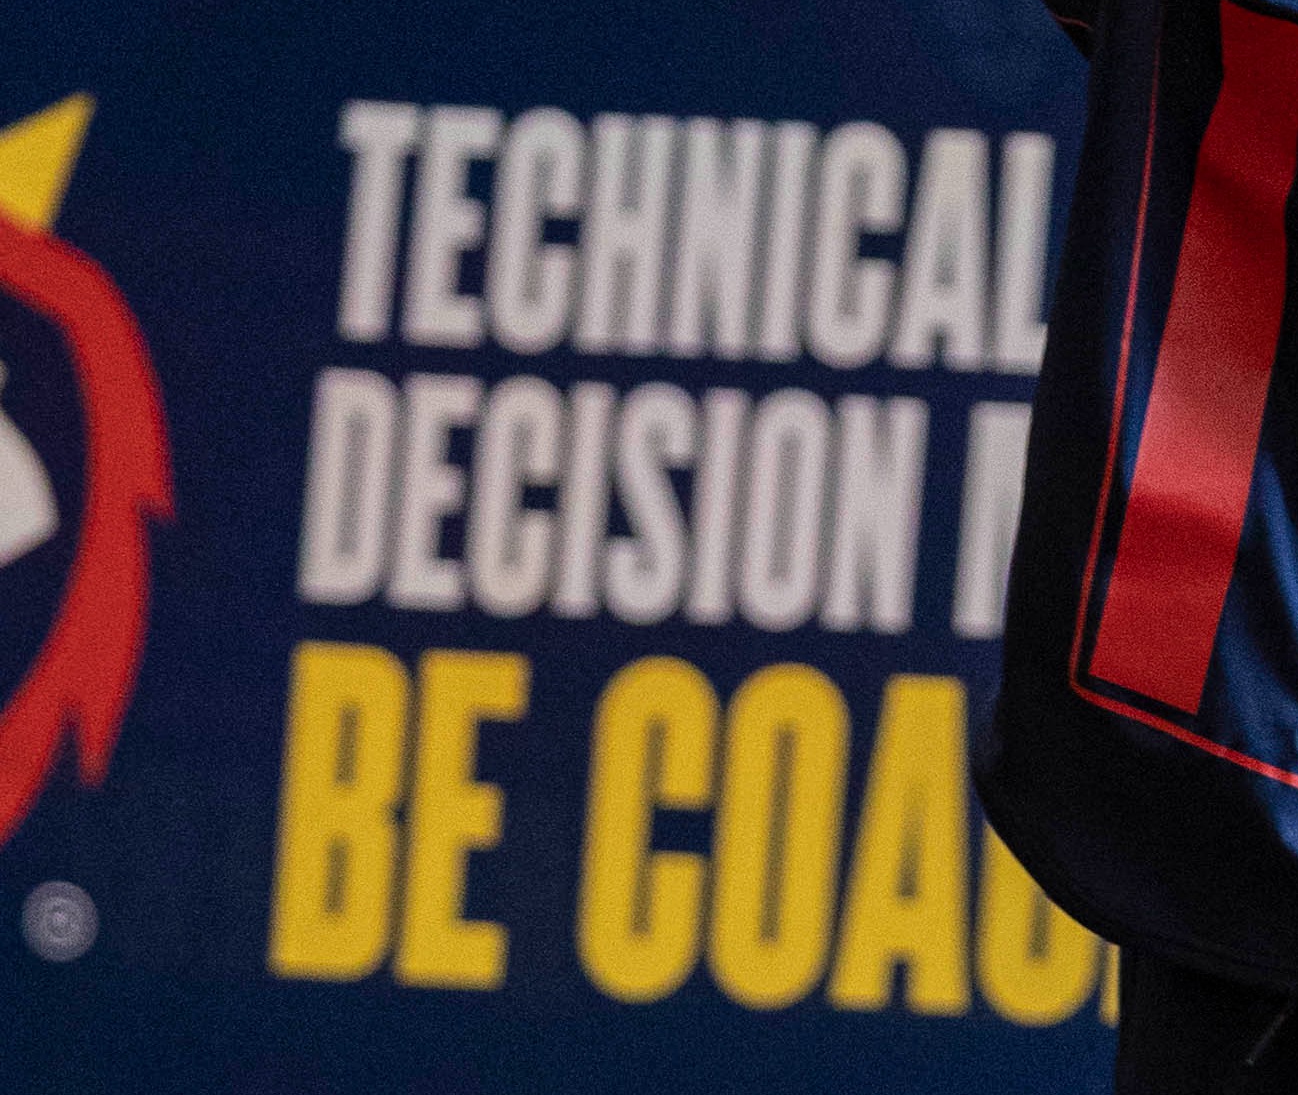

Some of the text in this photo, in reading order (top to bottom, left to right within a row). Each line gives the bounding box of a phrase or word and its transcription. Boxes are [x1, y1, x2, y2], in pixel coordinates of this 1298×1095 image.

[339, 102, 1055, 374] TECHNICAL
[299, 369, 929, 634] DECISION
[269, 641, 530, 988] BE
